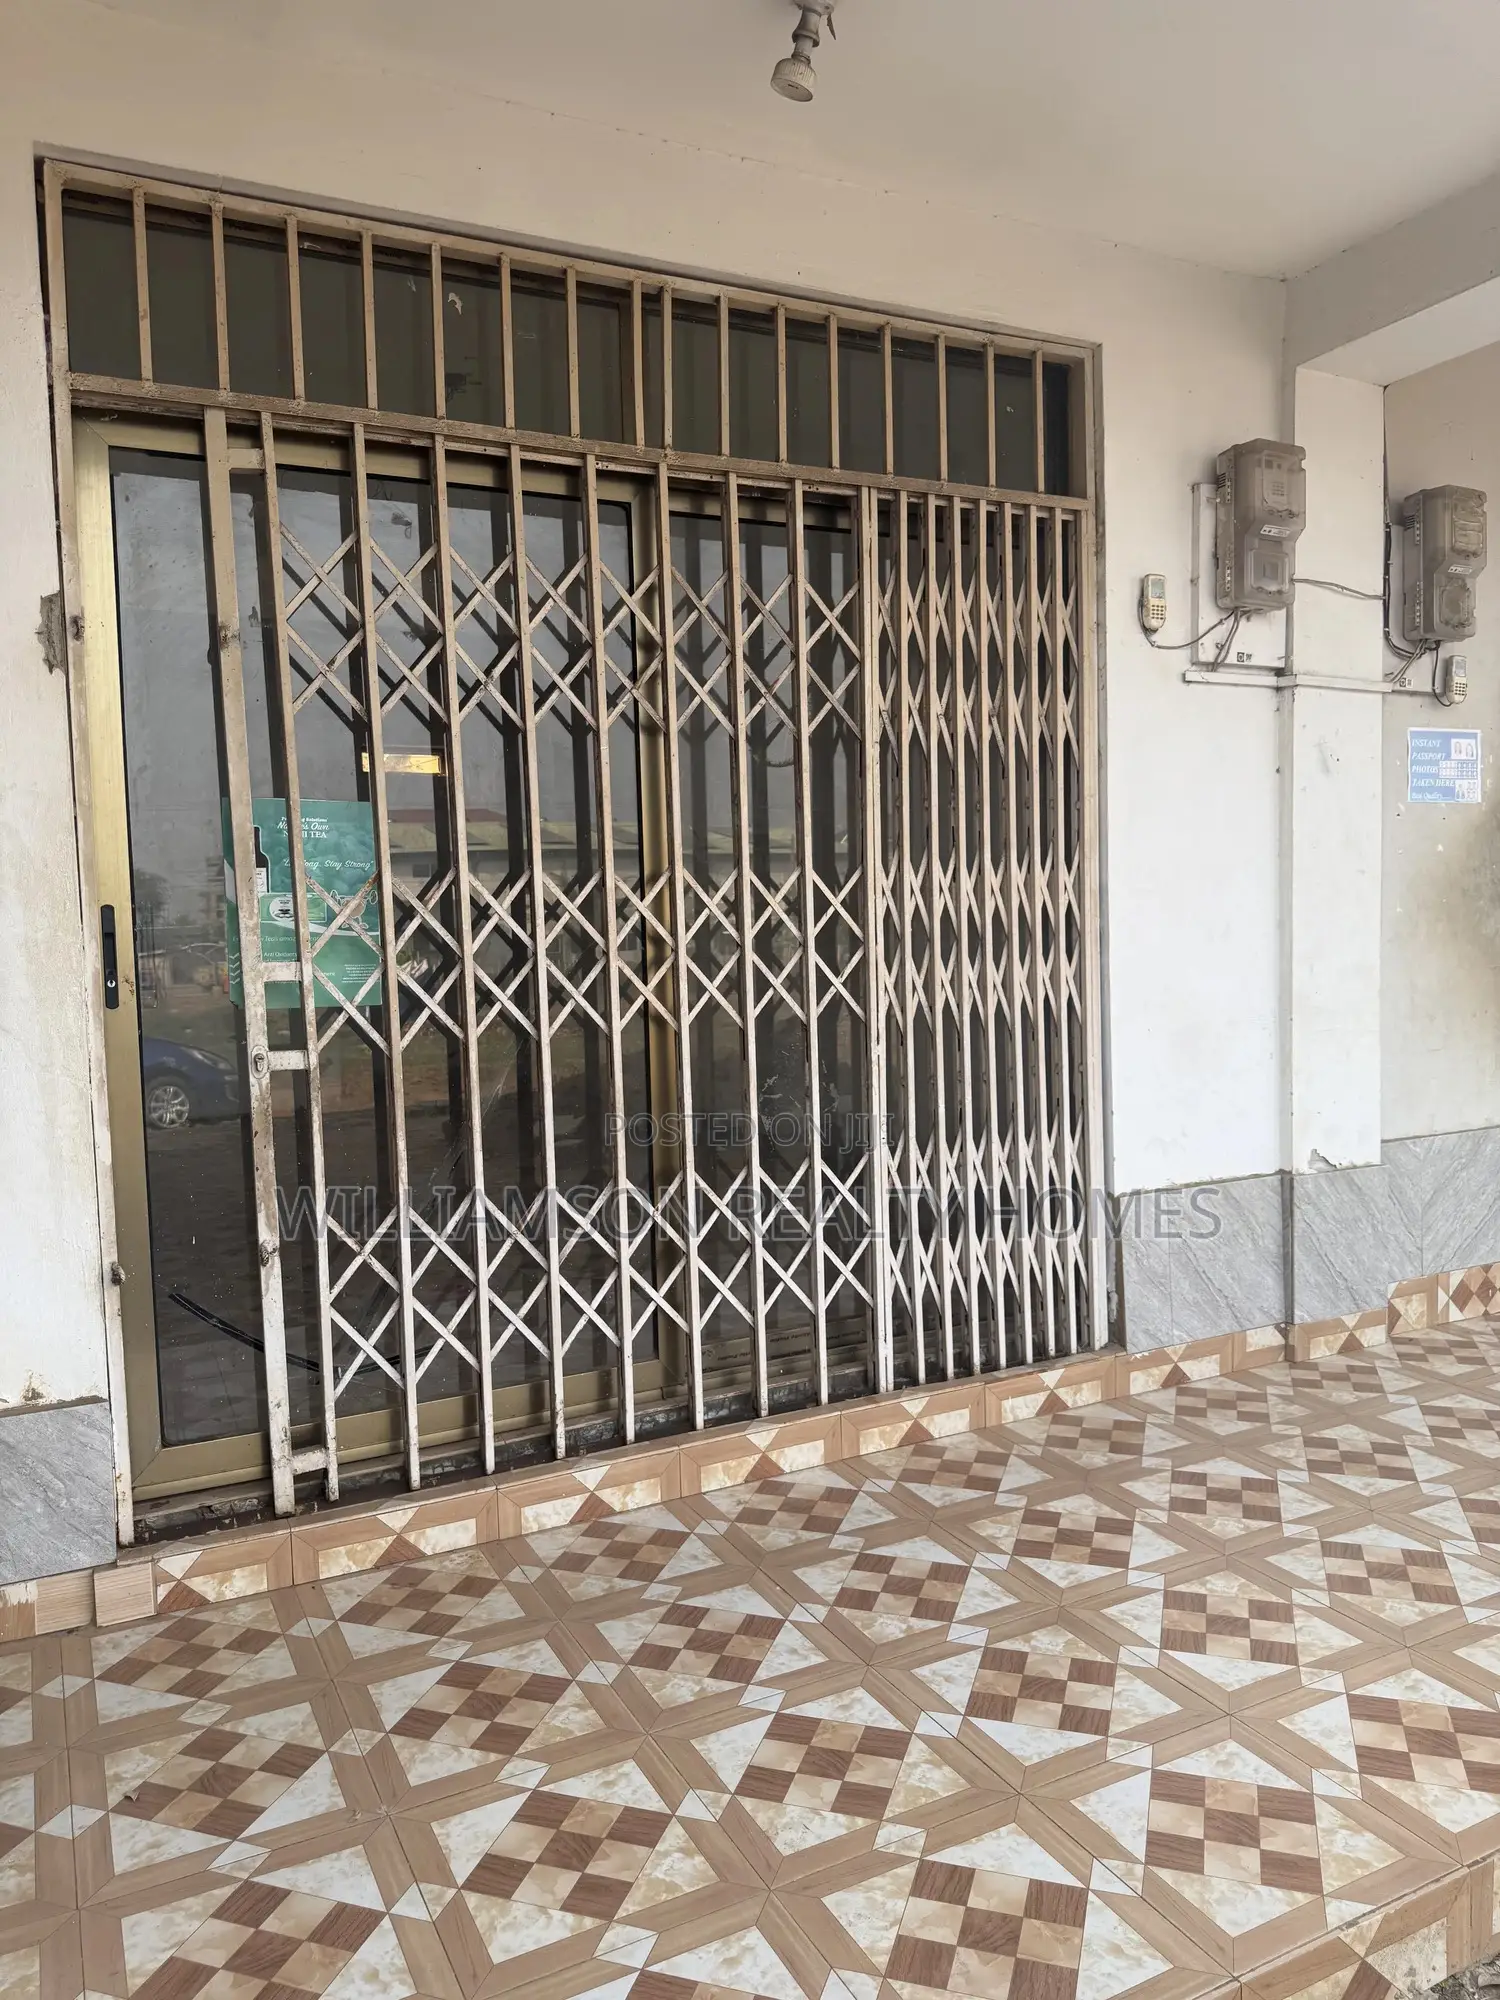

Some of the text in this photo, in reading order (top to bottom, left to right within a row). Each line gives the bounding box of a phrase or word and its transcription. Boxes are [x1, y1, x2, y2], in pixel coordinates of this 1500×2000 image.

[1411, 739, 1442, 747] INSTANT
[1411, 752, 1446, 760] PASSPORT
[1412, 778, 1455, 787] TAKEN HERE
[309, 831, 327, 839] TEA
[324, 859, 342, 871] Stay
